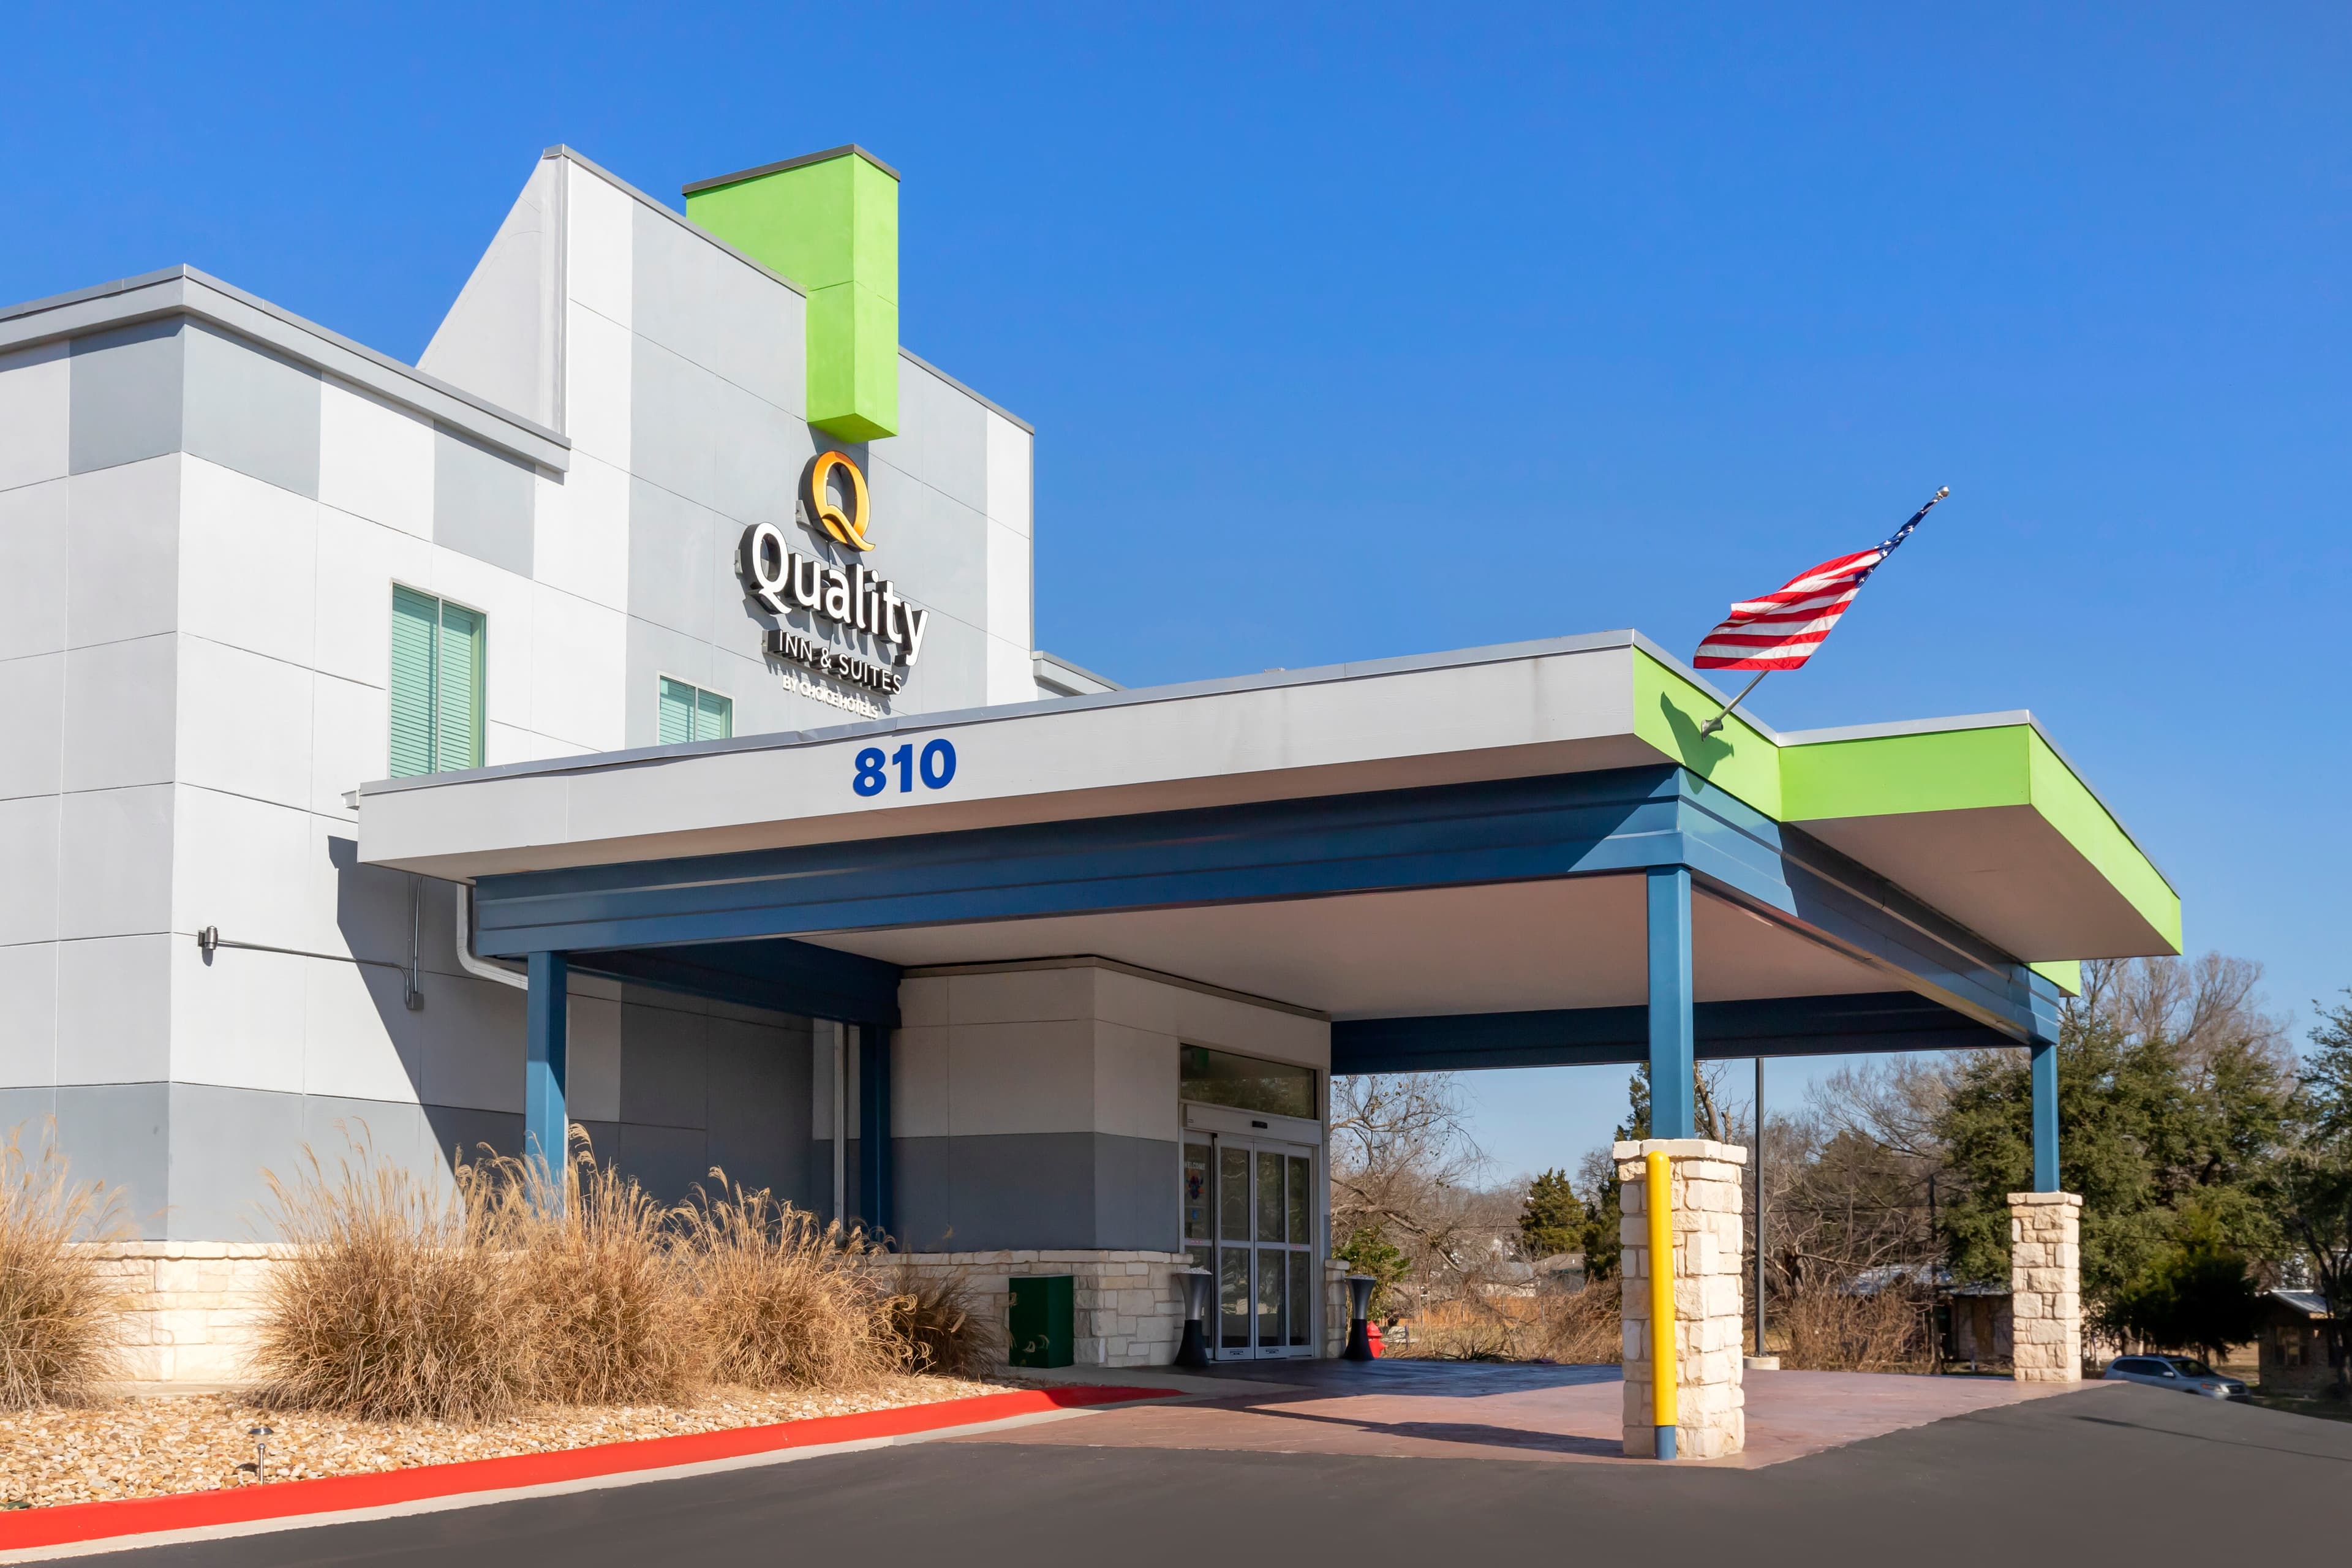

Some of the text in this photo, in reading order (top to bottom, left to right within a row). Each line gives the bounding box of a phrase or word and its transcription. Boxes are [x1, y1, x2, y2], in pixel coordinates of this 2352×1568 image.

[812, 451, 876, 551] Q
[752, 522, 929, 666] Quality
[779, 630, 902, 695] INN & SUITES
[783, 674, 878, 719] BY CHOICE HOTELS
[852, 738, 957, 797] 810
